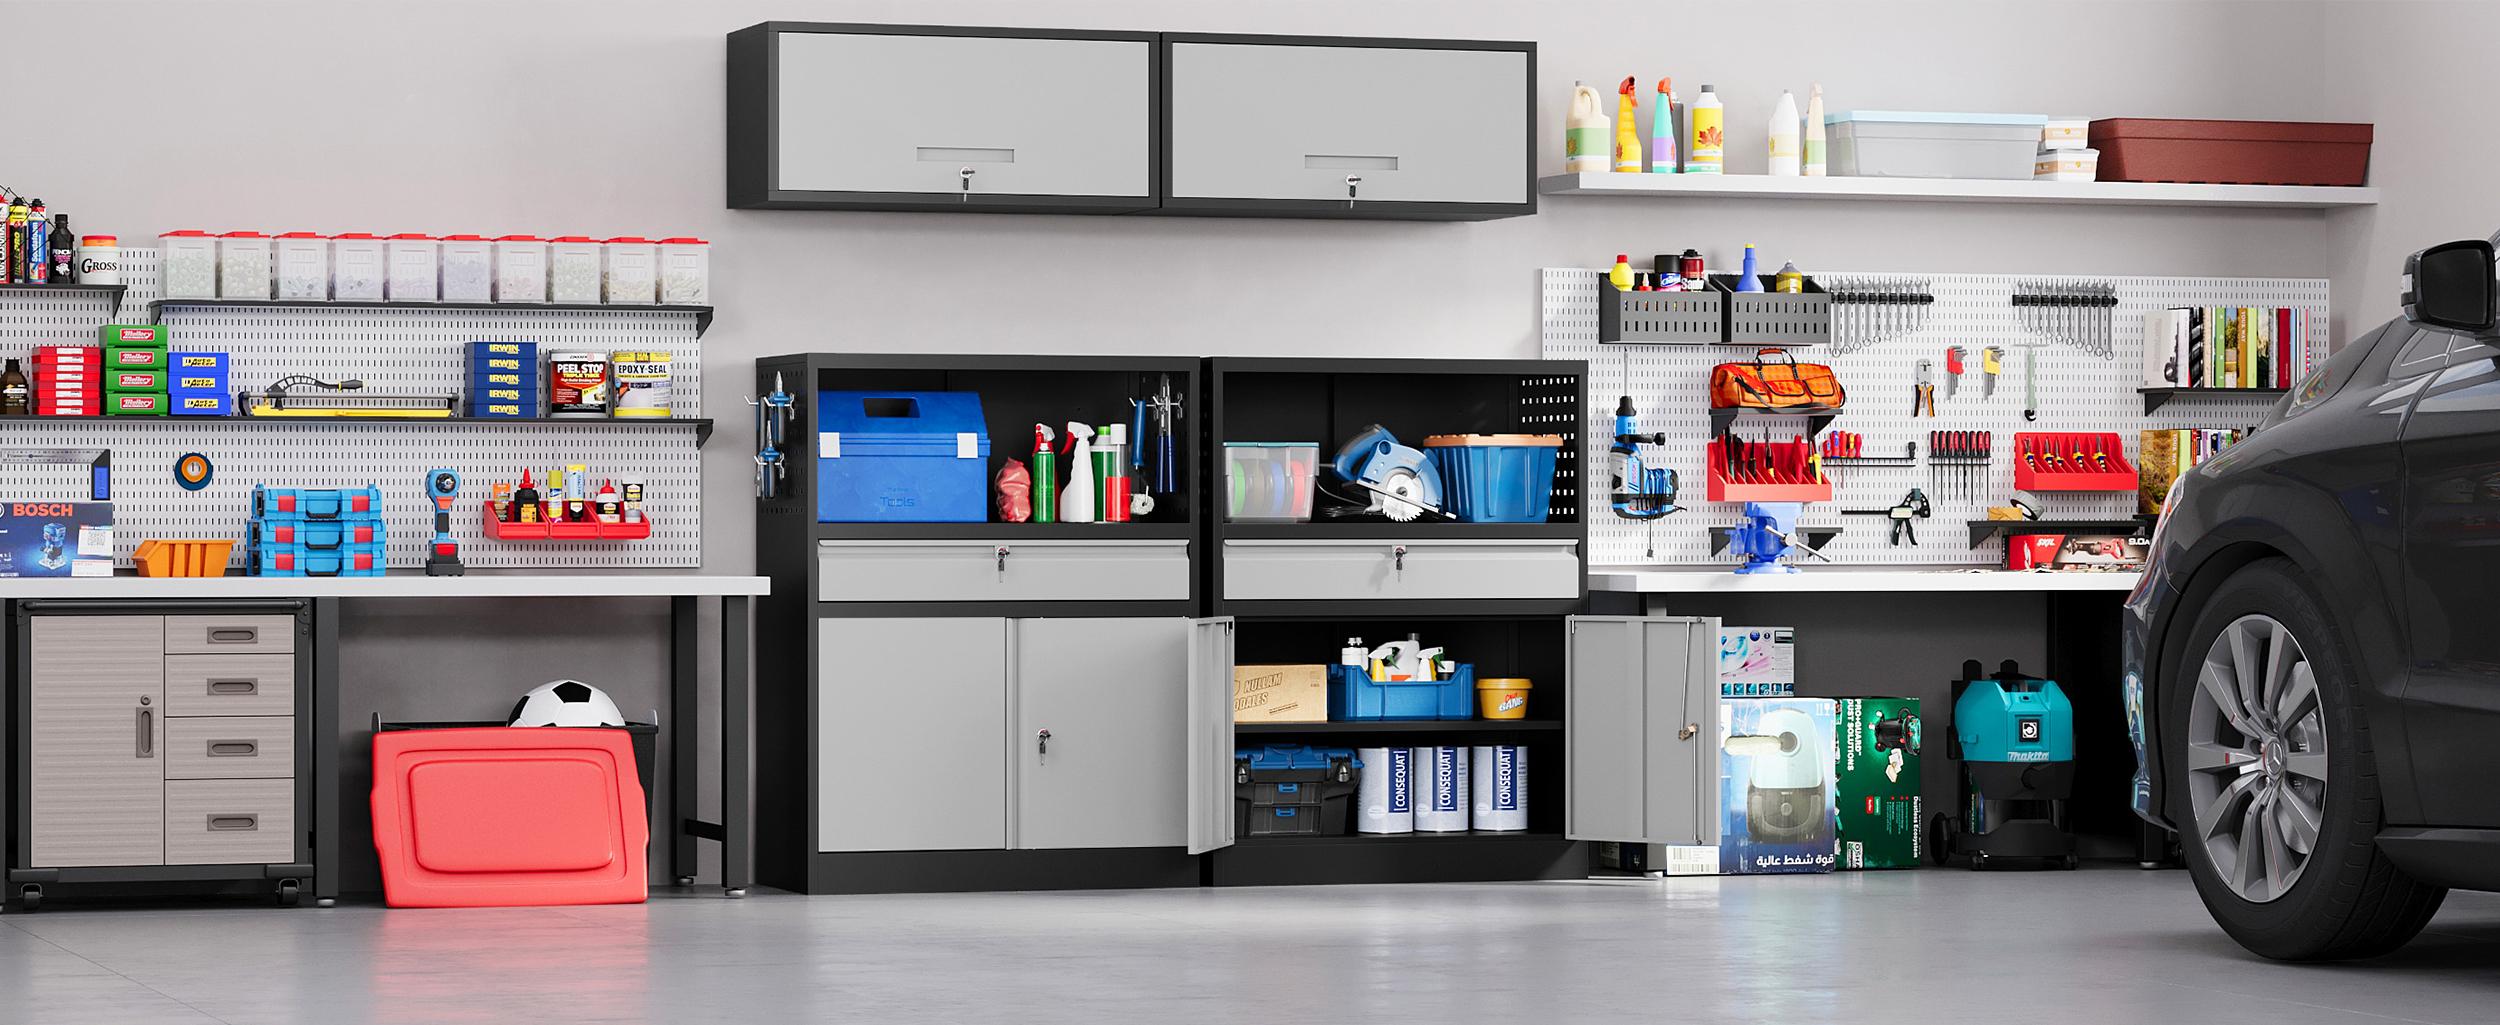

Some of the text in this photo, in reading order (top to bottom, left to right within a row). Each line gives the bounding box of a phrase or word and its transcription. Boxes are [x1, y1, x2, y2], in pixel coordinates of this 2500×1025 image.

[81, 258, 118, 273] GROSS
[489, 344, 519, 353] IRWIN
[489, 359, 519, 368] IRWIN
[557, 363, 604, 373] PEEL STOP
[489, 374, 519, 383] IRWIN
[489, 389, 519, 398] IRWIN
[489, 405, 519, 414] IRWIN
[13, 503, 73, 517] BOSCH
[2036, 538, 2056, 547] SKIL
[1244, 672, 1283, 694] NULLAM
[1234, 692, 1268, 712] ODALES
[1395, 754, 1406, 807] CONSEQUAT
[1440, 752, 1451, 806] CONSEQUAT
[1500, 752, 1511, 805] CONSEQUAT
[1756, 853, 1834, 868] قوة شفط عالية
